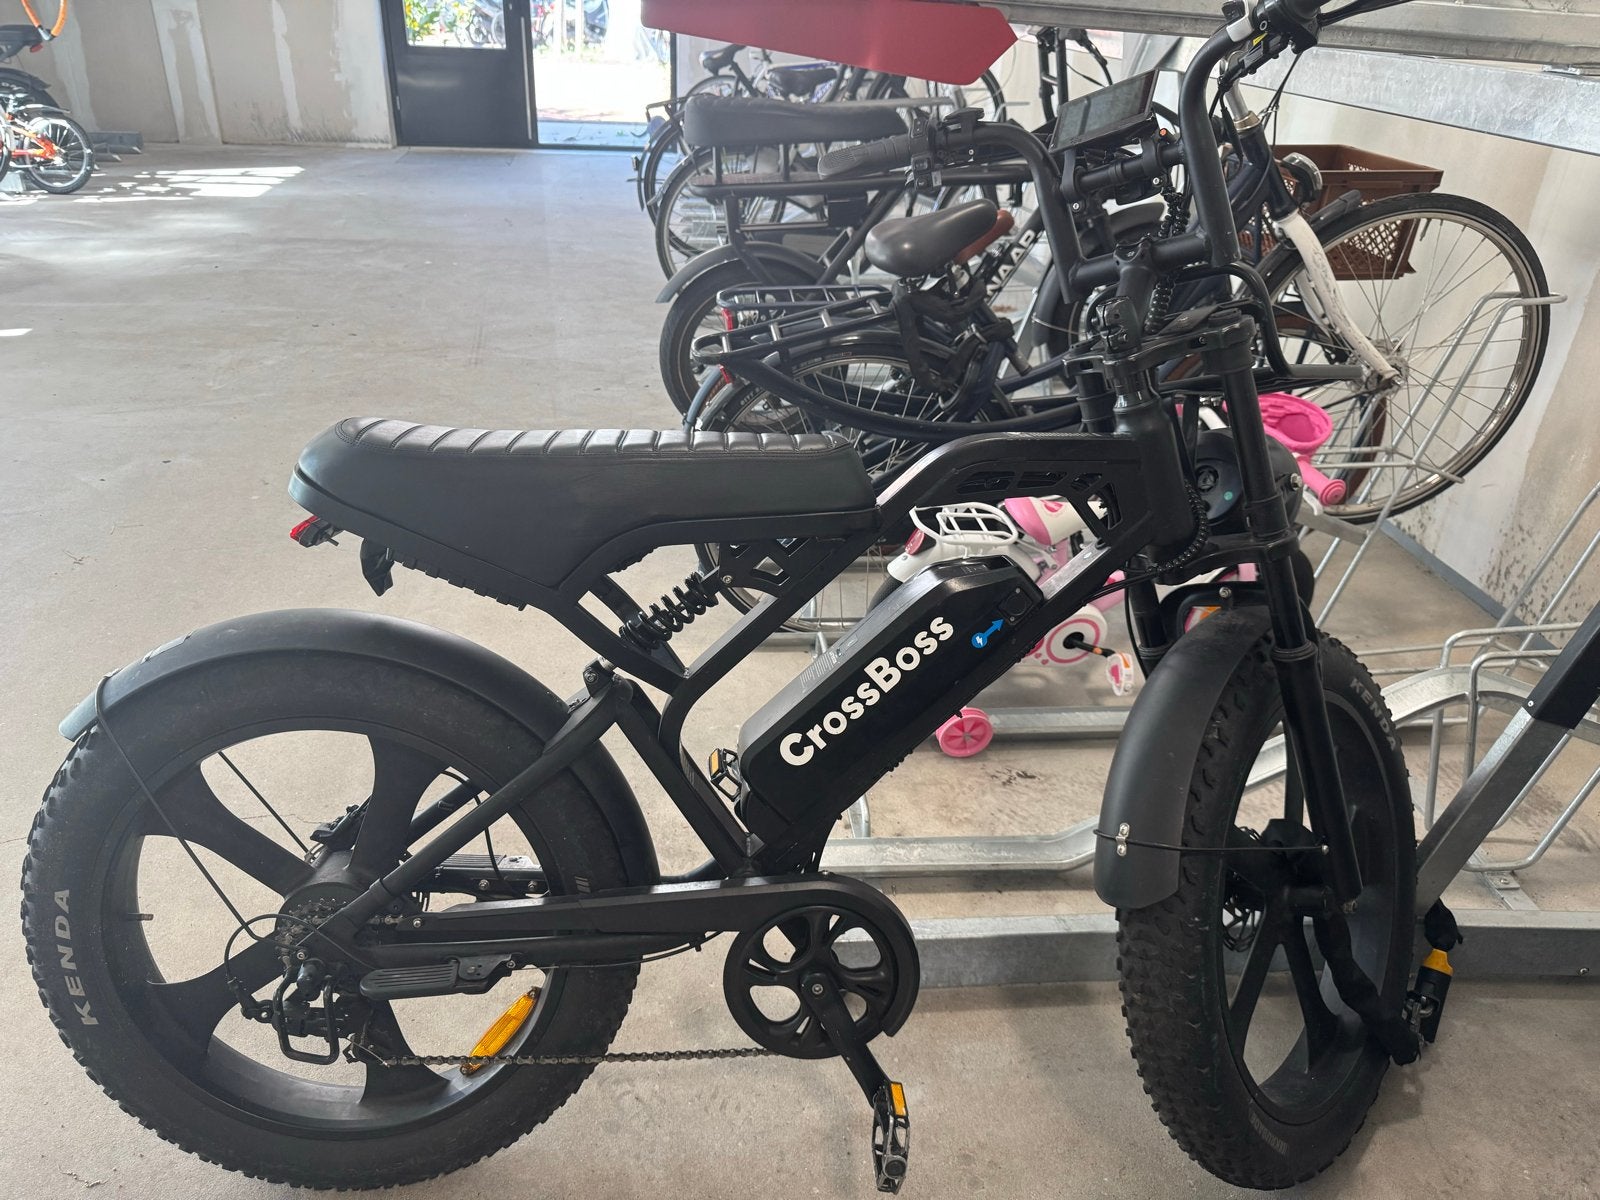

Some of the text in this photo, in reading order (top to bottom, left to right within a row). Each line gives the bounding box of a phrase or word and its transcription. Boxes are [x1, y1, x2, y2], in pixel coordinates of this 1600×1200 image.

[984, 229, 1036, 304] NAAP
[779, 616, 954, 766] CrossBoss
[1350, 678, 1396, 751] KENDA
[54, 889, 99, 1025] KENDA
